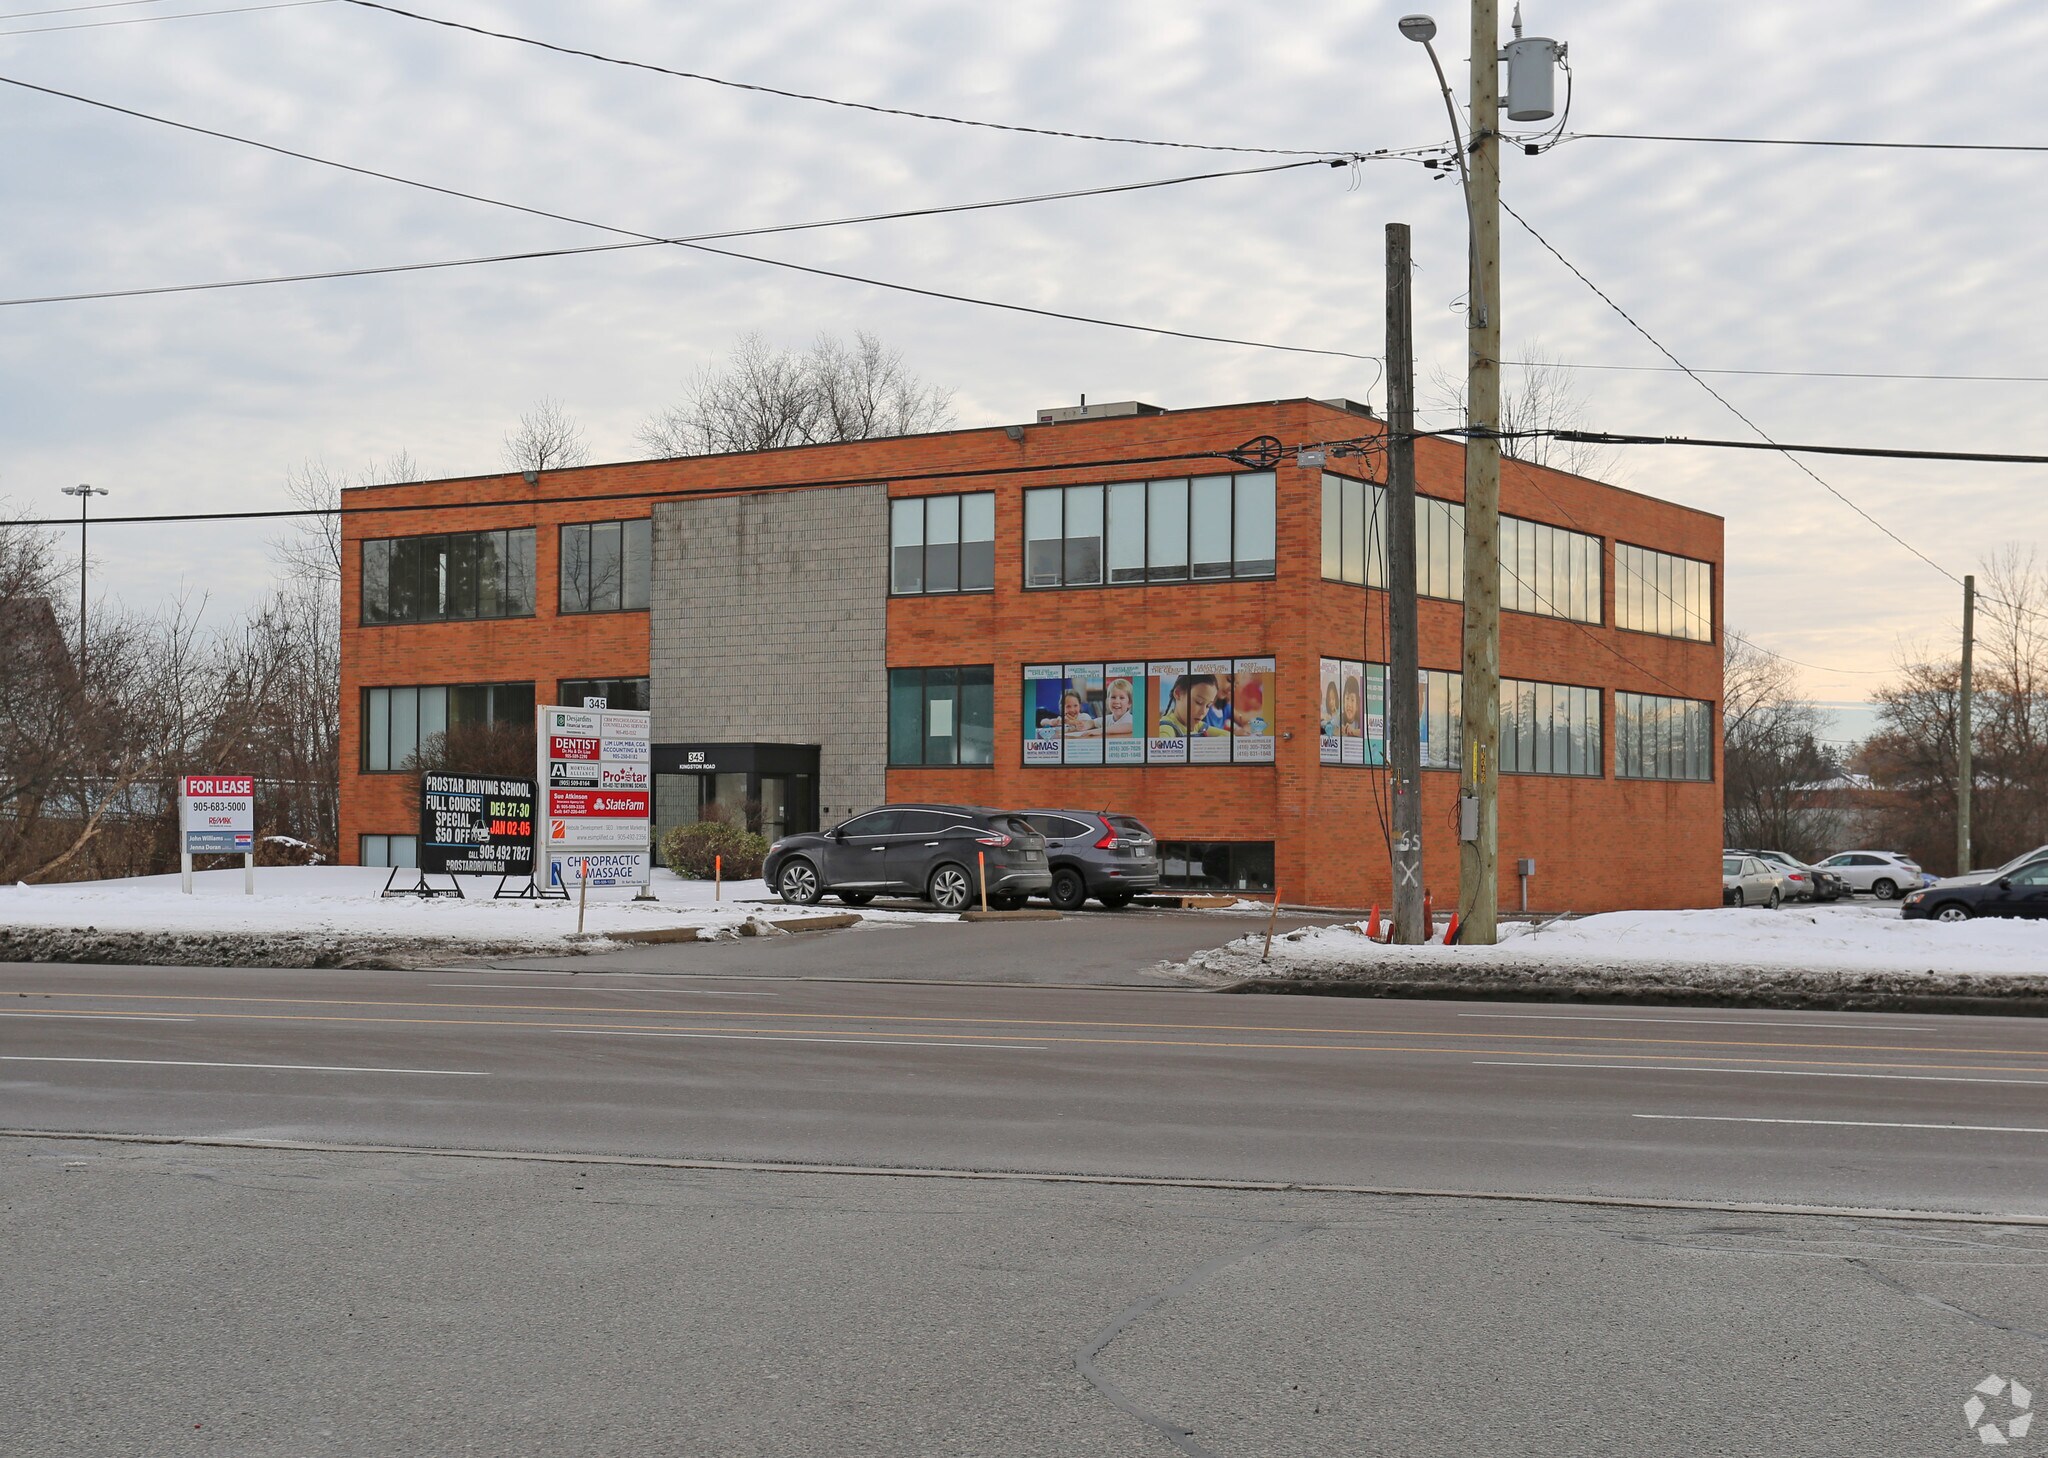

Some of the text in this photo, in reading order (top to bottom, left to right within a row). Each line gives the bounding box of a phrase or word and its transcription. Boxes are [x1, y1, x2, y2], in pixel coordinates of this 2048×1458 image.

[588, 698, 606, 709] 345
[566, 714, 592, 723] Desjardins
[555, 738, 597, 750] DENTIST
[689, 752, 704, 762] 345
[190, 780, 251, 794] FOR LEASE
[426, 776, 531, 797] PROSTAR DRIVING SCHOOL
[193, 802, 246, 811] 905-683-5000
[426, 795, 481, 813] FULL COURSE
[490, 801, 530, 818] DEC 27-30
[436, 812, 471, 828] SPECIAL
[490, 820, 531, 836] JAN 02-05
[435, 827, 471, 844] $50 OFF
[468, 844, 531, 861] CALL 905 492 7827
[446, 859, 505, 873] PROSTARDRIVING.CA
[575, 867, 633, 879] & MASSAGE
